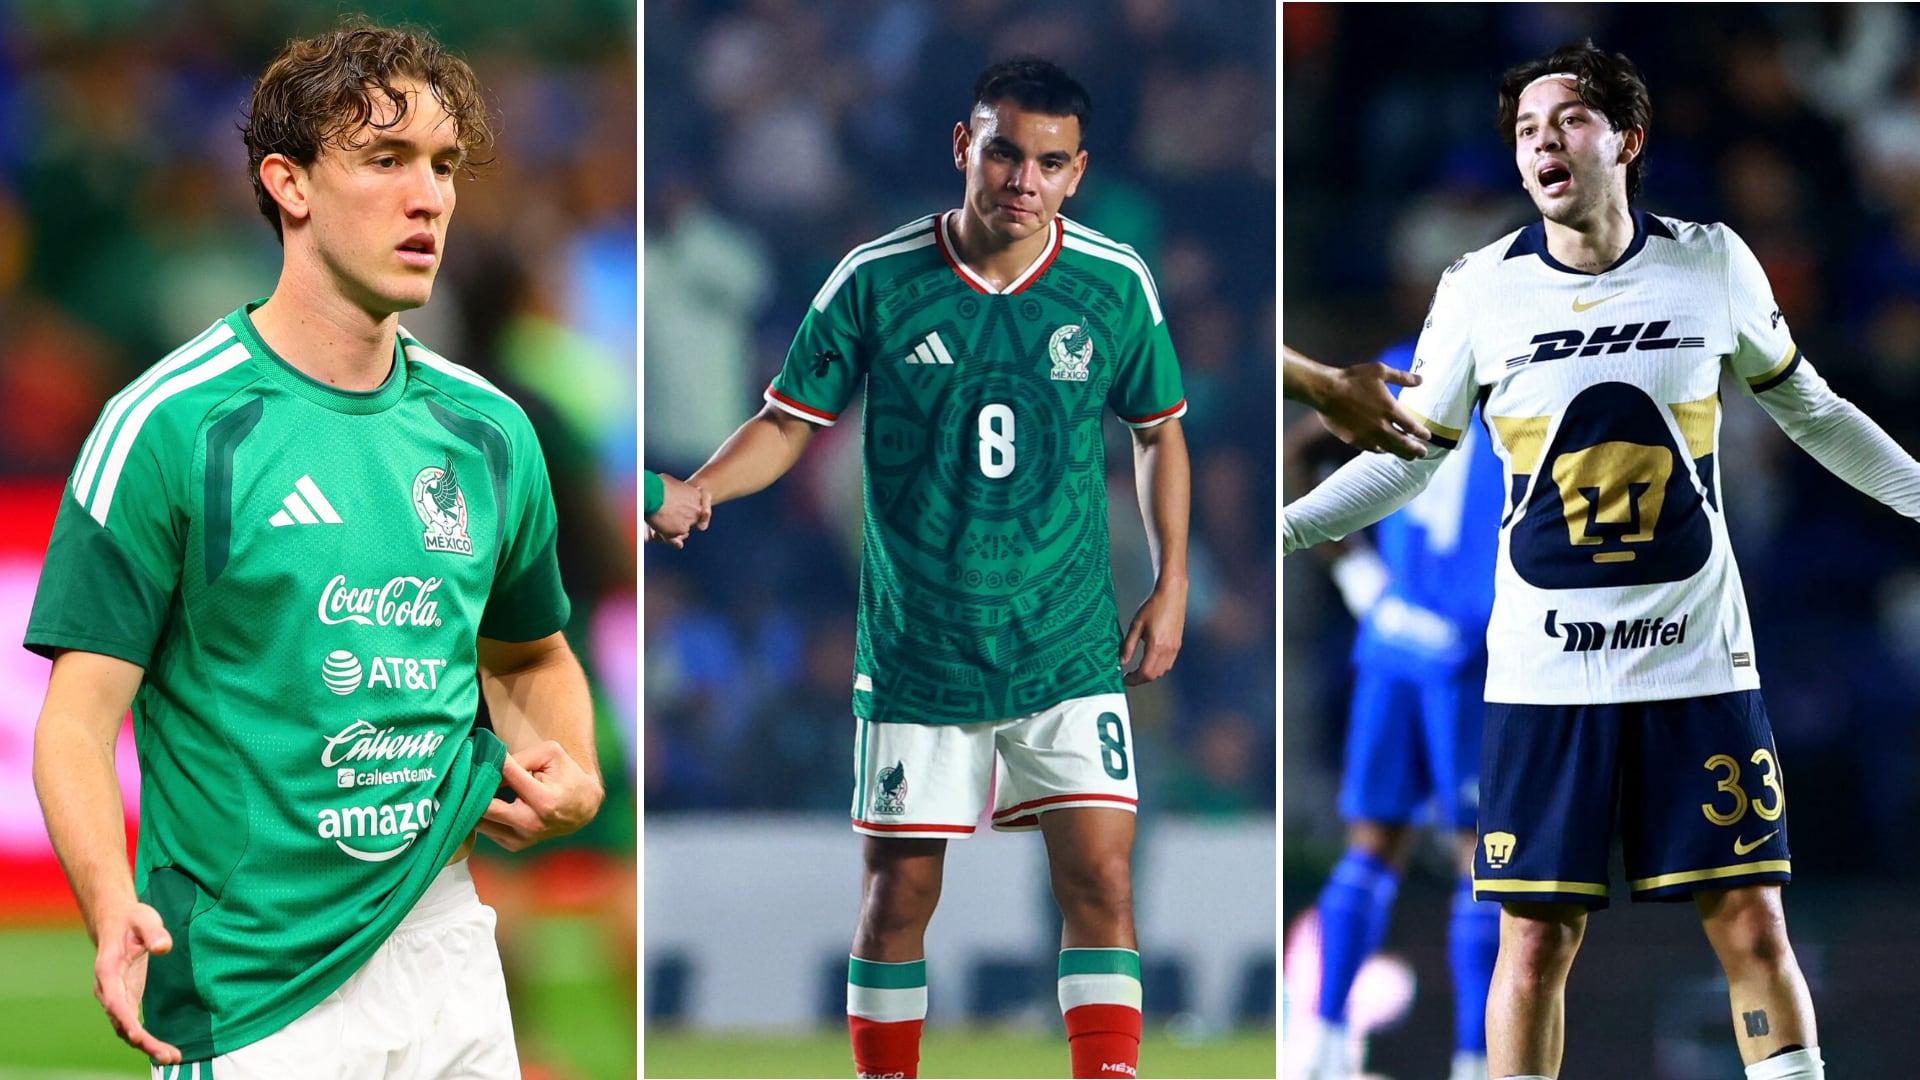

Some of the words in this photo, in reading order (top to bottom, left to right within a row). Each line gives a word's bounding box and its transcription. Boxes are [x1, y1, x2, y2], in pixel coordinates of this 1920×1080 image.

[1528, 320, 1683, 363] DHL
[978, 403, 1016, 479] 8
[425, 533, 471, 552] MÉXICO
[318, 574, 443, 627] Coca-Cola
[1610, 614, 1688, 650] Mifel
[367, 656, 441, 690] AT&T
[320, 718, 445, 768] Caliente
[1096, 711, 1129, 780] 8
[1701, 748, 1783, 826] 33
[317, 798, 440, 839] amazo
